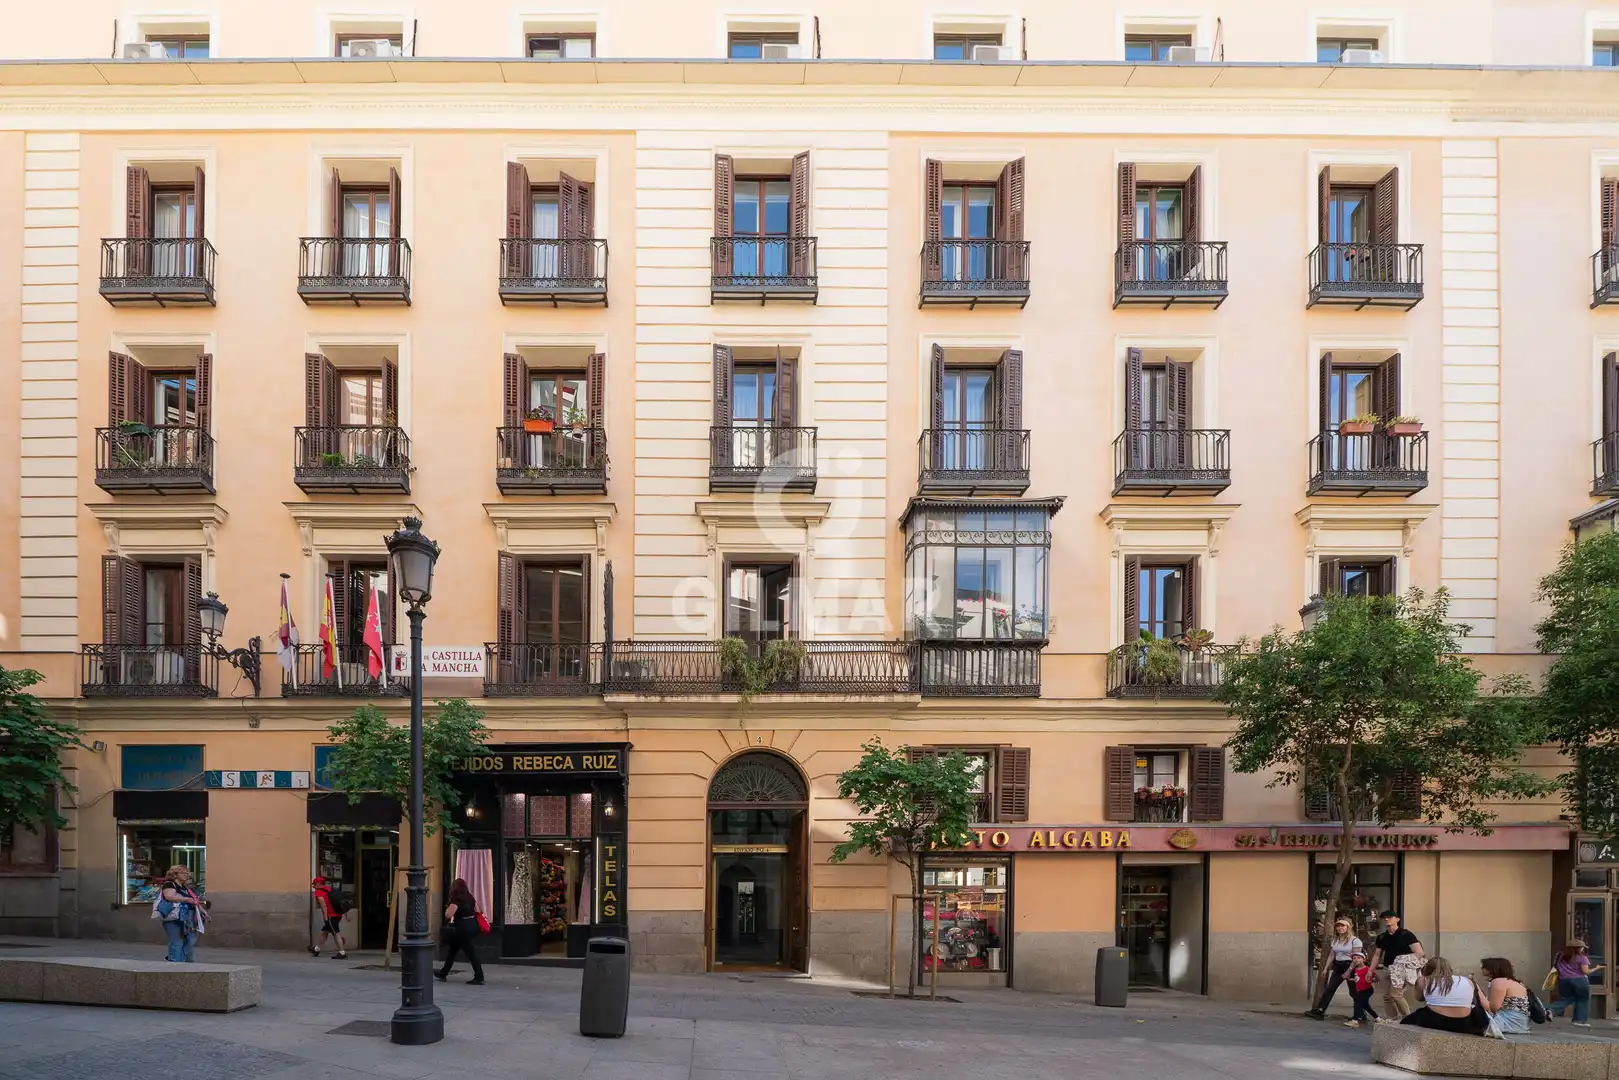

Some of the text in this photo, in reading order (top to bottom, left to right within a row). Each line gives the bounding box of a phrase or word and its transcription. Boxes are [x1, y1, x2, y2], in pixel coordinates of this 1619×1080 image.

[432, 651, 482, 661] CASTILLA
[432, 663, 479, 673] MANCHA
[756, 735, 763, 744] 4
[446, 755, 617, 771] EJIDOS REBECA RUIZ
[1029, 830, 1131, 848] ALGABA
[1238, 834, 1329, 847] SASRERIA
[603, 845, 617, 917] TELAS
